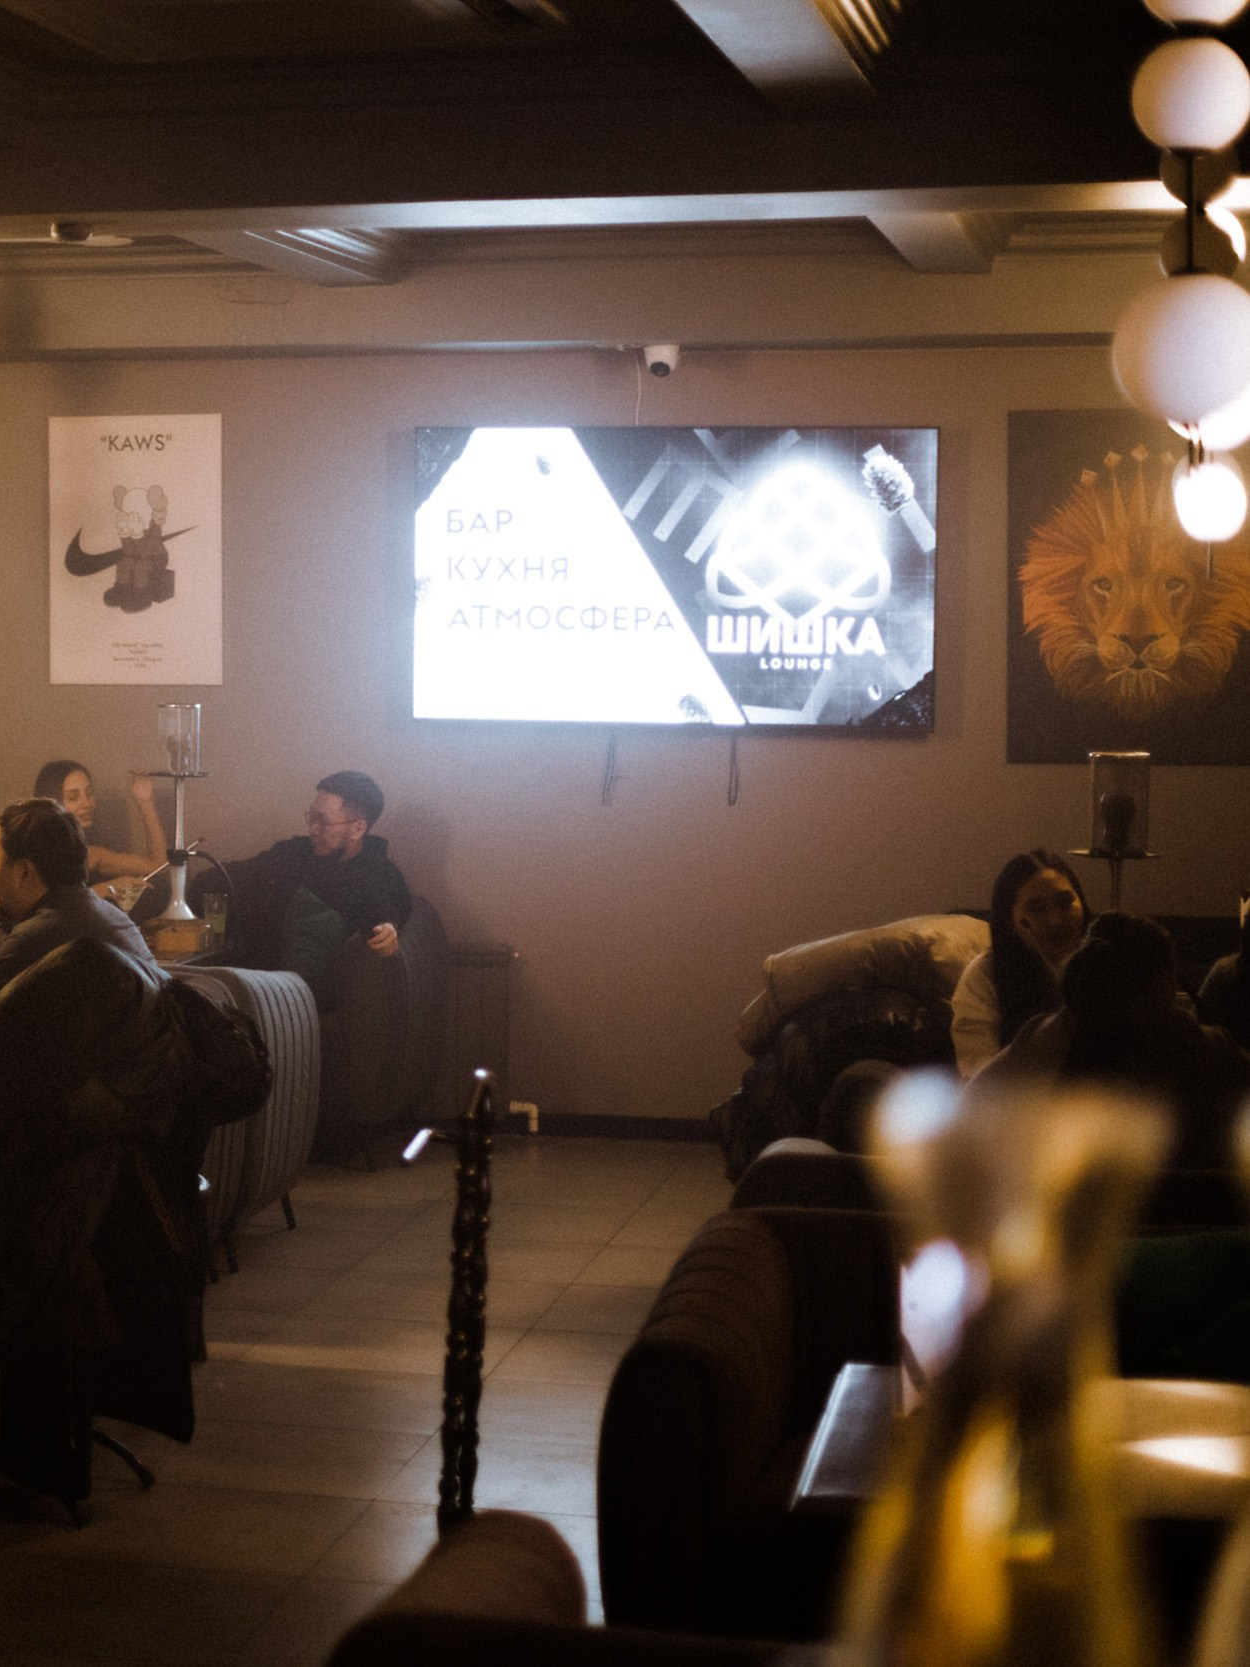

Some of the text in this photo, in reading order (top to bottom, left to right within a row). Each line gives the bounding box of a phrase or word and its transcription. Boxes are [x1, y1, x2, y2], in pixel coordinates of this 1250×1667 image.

[101, 434, 172, 451] "KAWS"
[447, 509, 513, 533] БАР
[448, 556, 568, 581] КУХНЯ
[448, 604, 676, 631] АТМОСФЕРА
[707, 615, 887, 656] ШИШКА
[760, 657, 832, 671] LOUNGE
